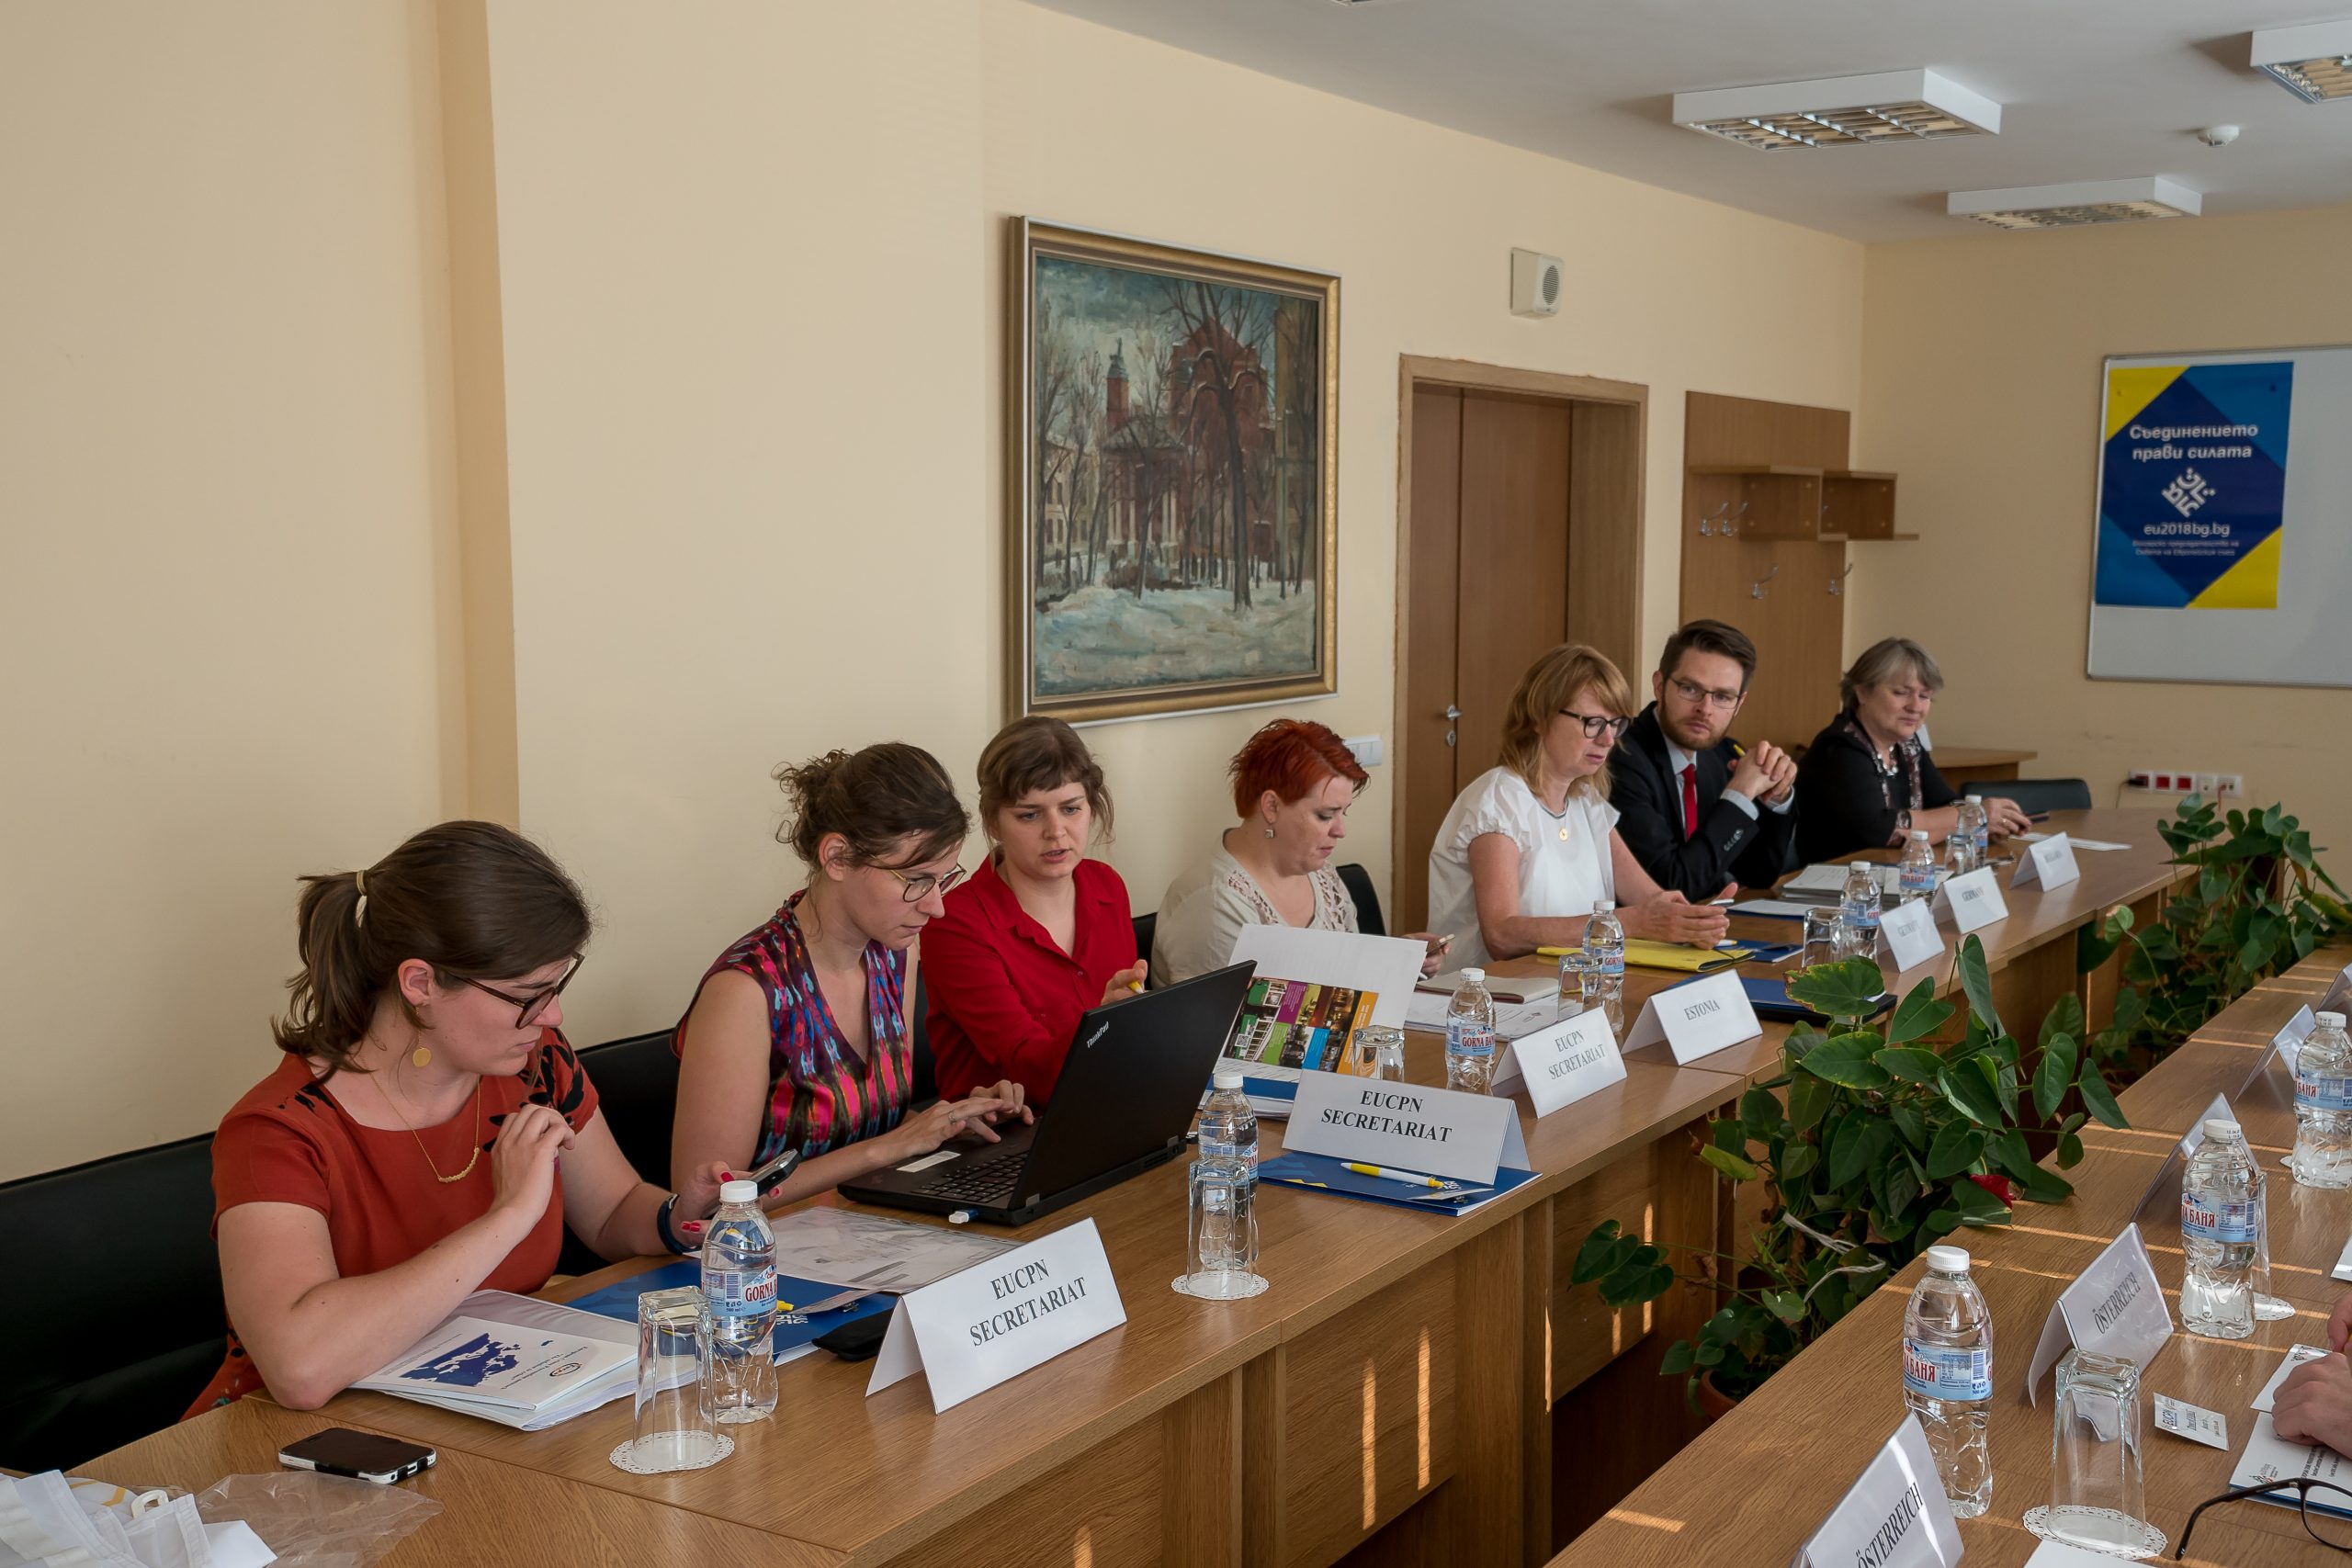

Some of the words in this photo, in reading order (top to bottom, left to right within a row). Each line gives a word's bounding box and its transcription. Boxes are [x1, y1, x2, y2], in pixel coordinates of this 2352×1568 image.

[2129, 423, 2259, 442] Съединението
[2132, 443, 2184, 463] прави
[2187, 445, 2254, 459] силата
[2143, 521, 2231, 537] eu2018bg.bg
[1683, 998, 1721, 1021] ESTONIA
[1462, 1036, 1485, 1047] GORNA
[1554, 1028, 1586, 1053] EUCPN
[1547, 1043, 1607, 1080] SECRETARIAT
[1359, 1089, 1424, 1114] EUCPN
[1320, 1108, 1453, 1143] SECRETARIAT
[2188, 1208, 2215, 1228] БАНЯ
[989, 1258, 1050, 1301] EUCPN
[969, 1277, 1088, 1348] SECRETARIAT
[2091, 1271, 2142, 1335] ÖSTERREICH
[1910, 1359, 1936, 1382] БАНЯ
[1855, 1482, 1924, 1568] ÖSTERREICH
